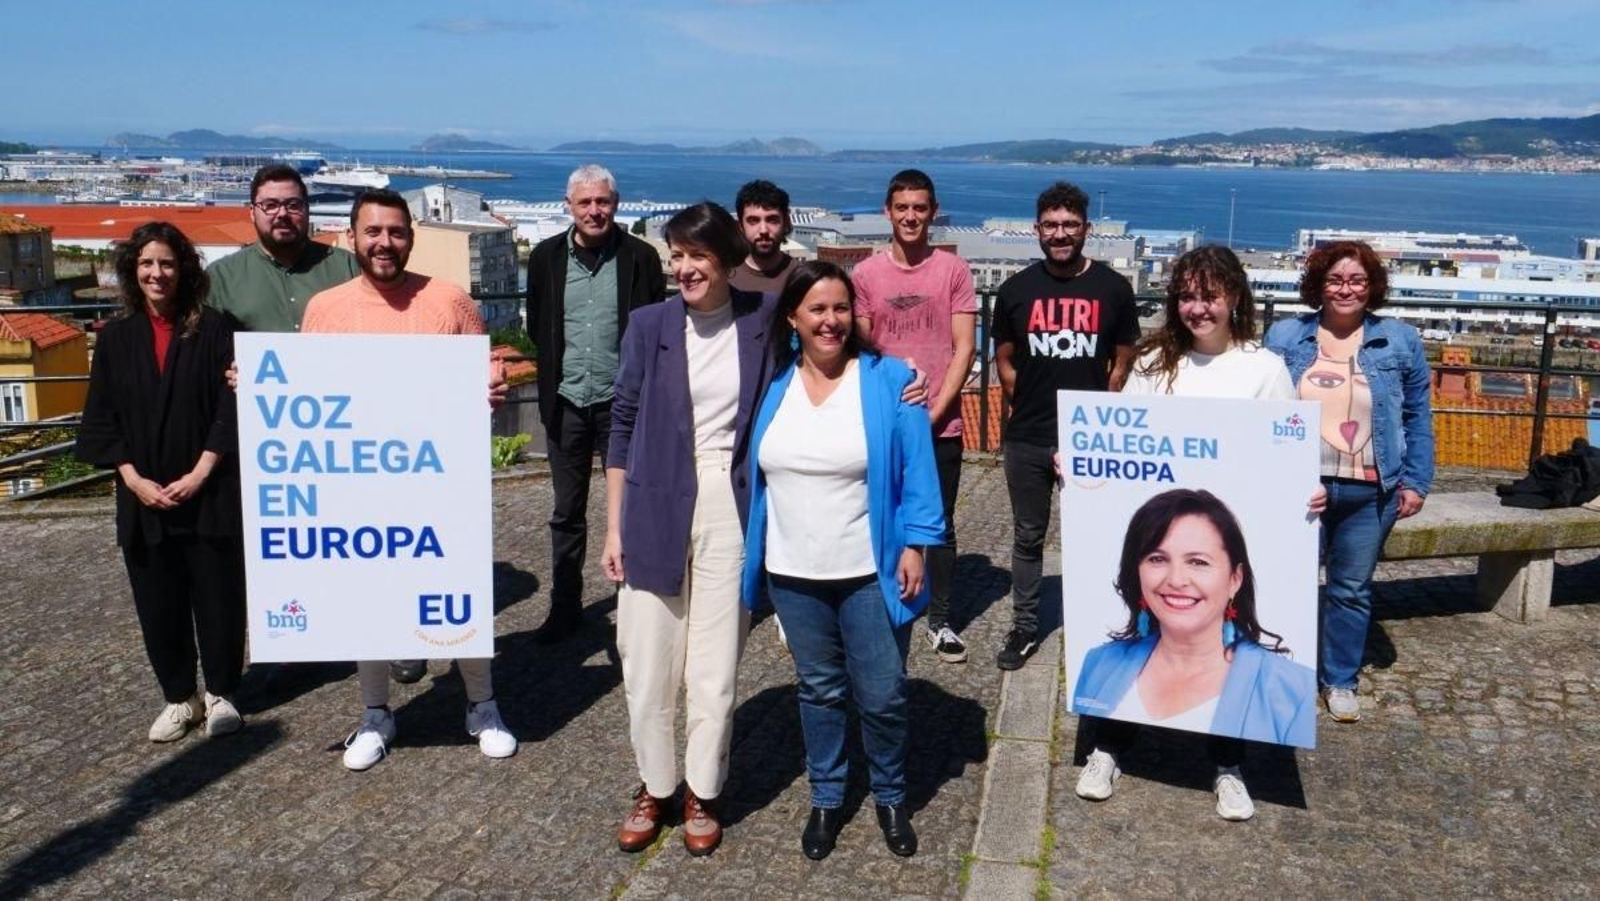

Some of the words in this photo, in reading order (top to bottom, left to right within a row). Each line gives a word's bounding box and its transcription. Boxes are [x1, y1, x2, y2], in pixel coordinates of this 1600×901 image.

[1028, 298, 1099, 332] ALTRI
[1028, 328, 1098, 359] NON
[254, 349, 288, 384] A
[255, 394, 352, 430] VOZ
[1071, 405, 1089, 426] A
[1095, 406, 1148, 429] VOZ
[1071, 431, 1175, 458] GALEGA
[1183, 437, 1218, 459] EN
[1273, 420, 1306, 441] bng
[256, 439, 444, 475] GALEGA
[1072, 456, 1175, 483] EUROPA
[258, 483, 318, 518] EN
[260, 525, 445, 560] EUROPA
[266, 609, 307, 631] bng
[418, 594, 472, 626] EU
